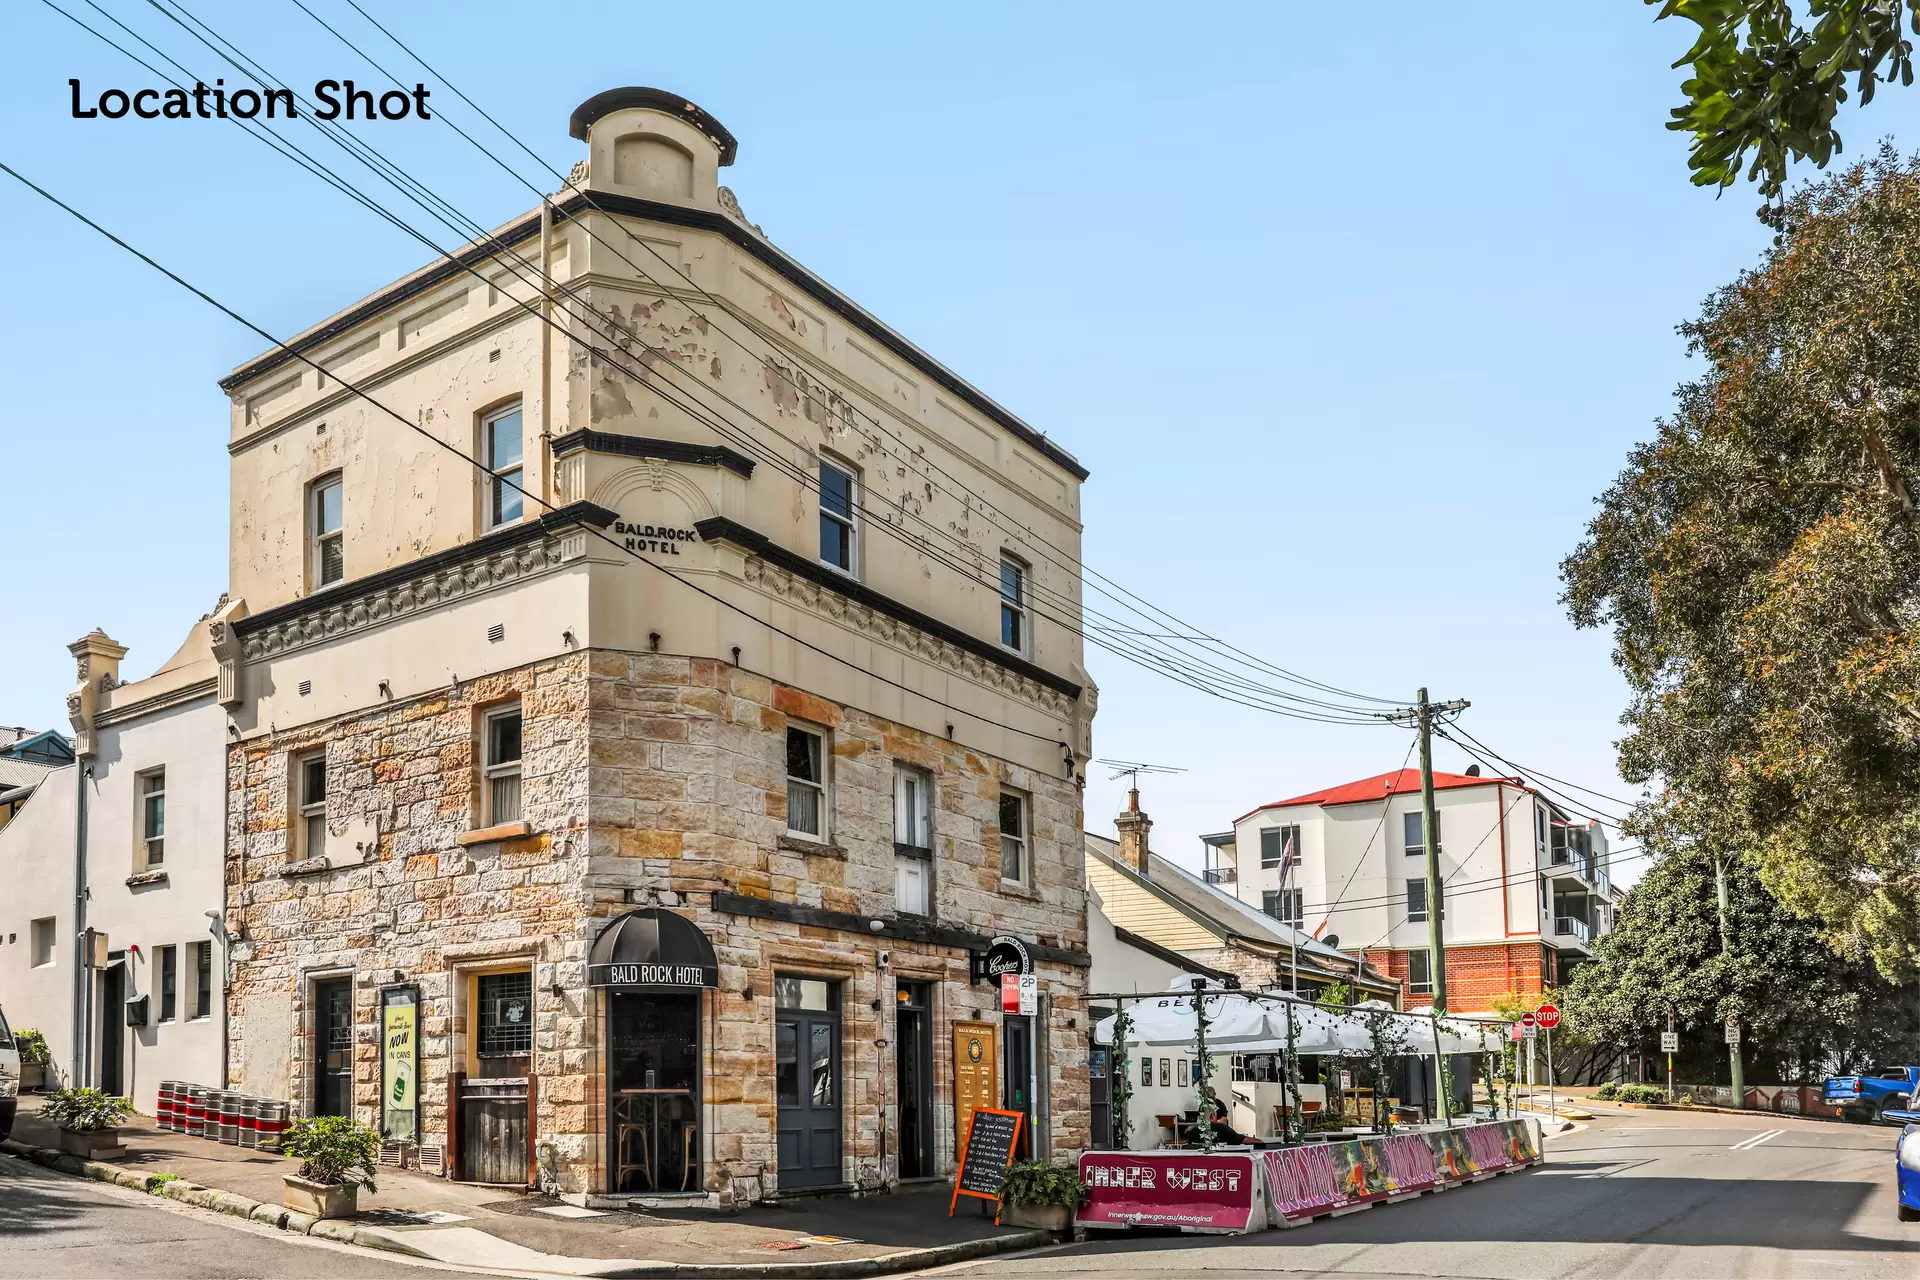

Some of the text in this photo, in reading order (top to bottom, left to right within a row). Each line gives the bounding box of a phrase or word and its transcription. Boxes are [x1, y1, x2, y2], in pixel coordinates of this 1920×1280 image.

[625, 537, 680, 555] HOTEL
[1004, 937, 1016, 945] BALD
[1016, 944, 1026, 957] ROCK
[989, 954, 1018, 976] Coopers
[611, 965, 704, 985] BALD ROCK HOTEL
[1021, 977, 1035, 988] 2P
[1536, 1011, 1559, 1022] STOP
[389, 1031, 410, 1049] NOW
[389, 1050, 412, 1060] IN CANS
[1085, 1165, 1242, 1191] INNER WEST
[1107, 1211, 1213, 1223] innerwesnsw.gov.au/Aboriginal
